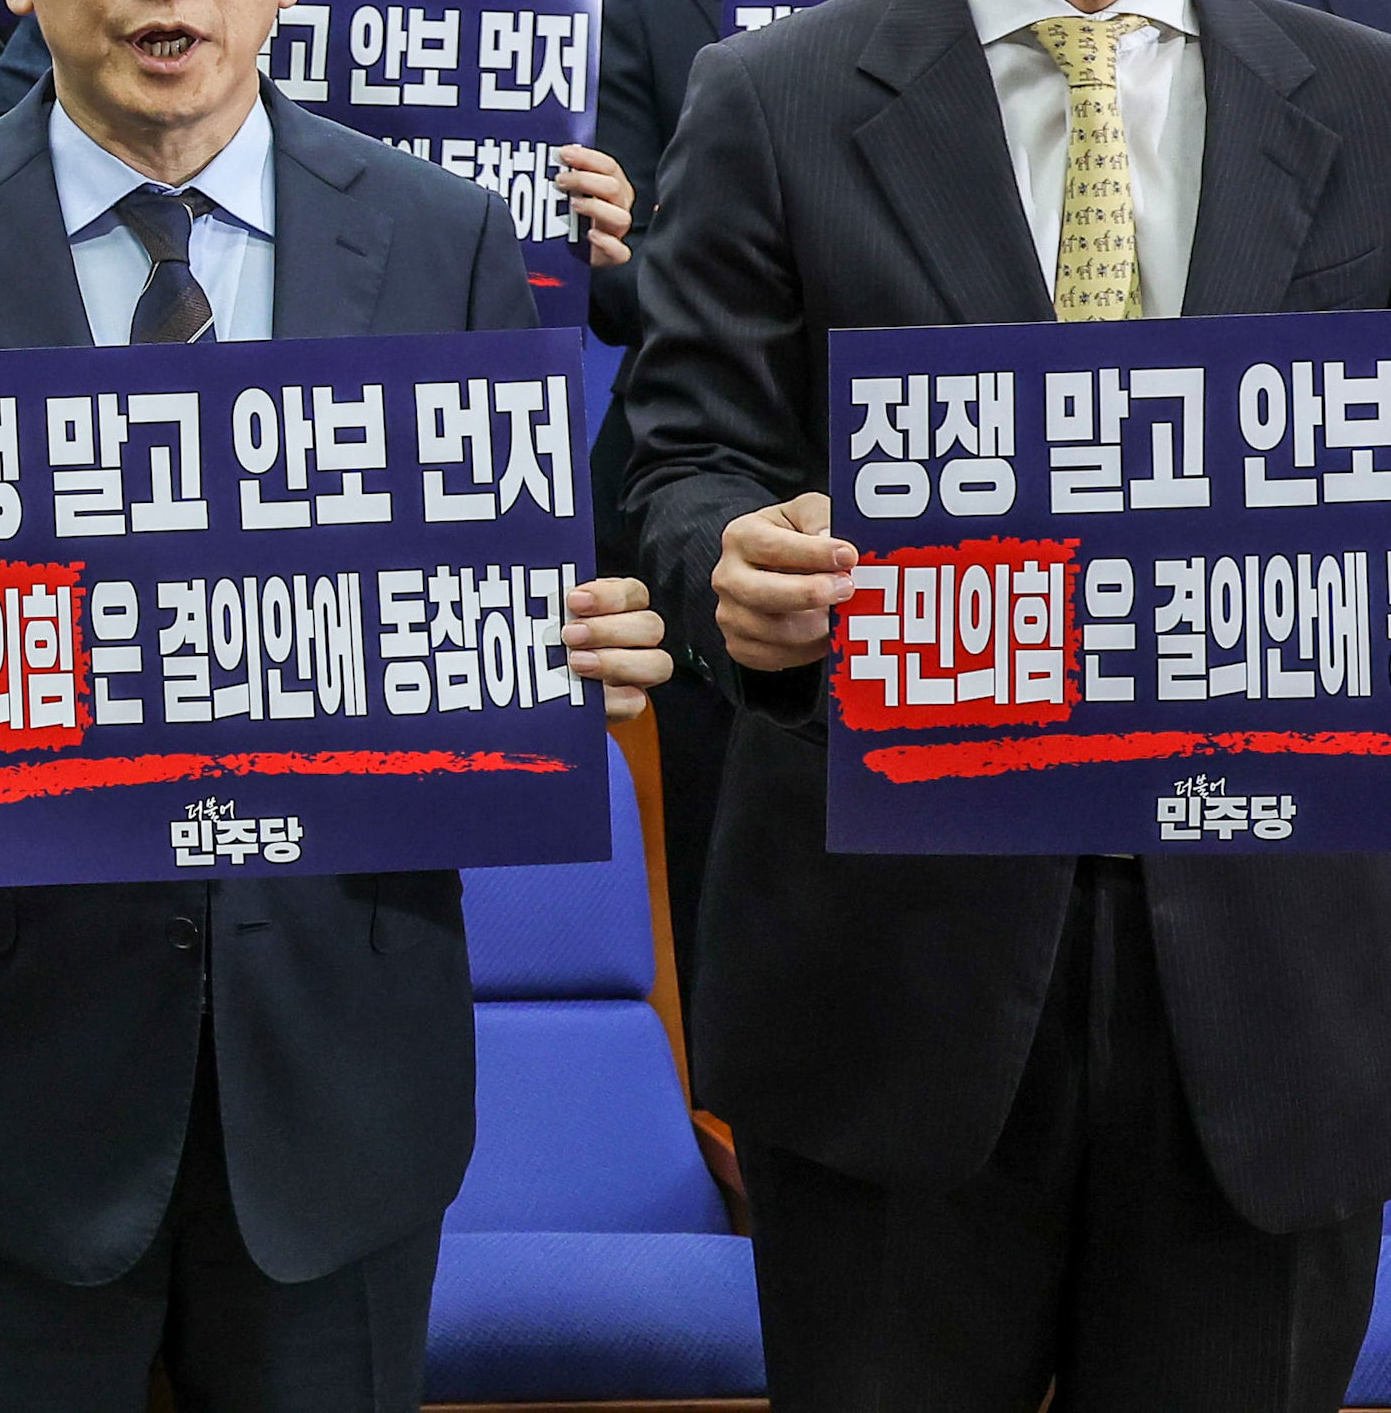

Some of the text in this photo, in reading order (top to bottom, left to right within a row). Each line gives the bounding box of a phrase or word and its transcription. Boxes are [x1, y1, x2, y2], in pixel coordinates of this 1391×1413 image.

[350, 5, 460, 107] 안보
[479, 11, 589, 113] 먼저
[46, 391, 209, 538] 말고
[232, 384, 392, 532] 안보
[413, 374, 574, 524] 먼저
[850, 360, 1391, 519] 정쟁 말고 안보
[91, 580, 144, 726] 은
[157, 572, 367, 725] 결의안에
[376, 562, 586, 717] 동참하라
[848, 551, 1373, 707] 국민의힘 은 결의안에
[185, 798, 236, 821] 더불어
[1155, 794, 1297, 841] 민주당
[1173, 773, 1227, 799] 더불어
[169, 817, 304, 868] 민주당
